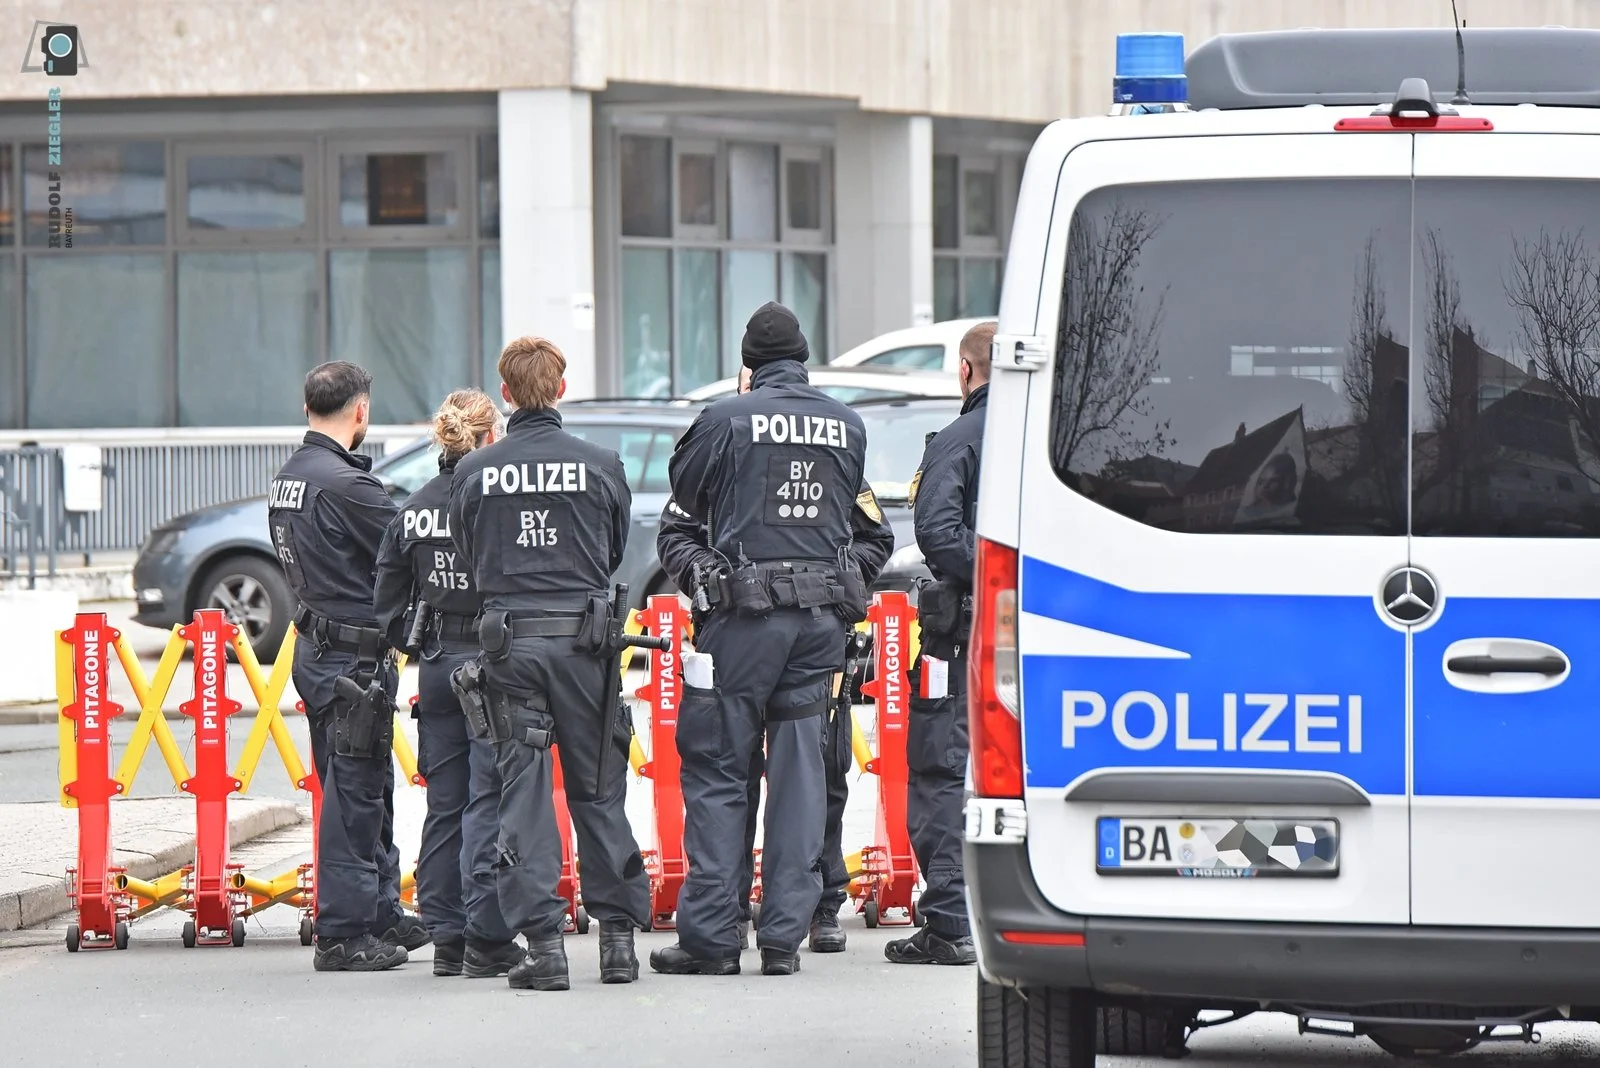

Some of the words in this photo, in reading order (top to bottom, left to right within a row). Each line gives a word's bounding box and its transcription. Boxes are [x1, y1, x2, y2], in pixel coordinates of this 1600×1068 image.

[751, 413, 847, 449] POLIZEI
[482, 462, 587, 495] POLIZEI
[790, 461, 815, 480] BY
[269, 480, 307, 509] OLIZEI
[776, 482, 824, 501] 4110
[520, 510, 550, 530] BY
[516, 528, 558, 548] 4113
[434, 551, 456, 570] BY
[427, 570, 469, 590] 4113
[84, 630, 99, 729] PITAGONE
[203, 630, 217, 729] PITAGONE
[886, 615, 901, 714] PITAGONE
[1062, 690, 1362, 754] POLIZEI
[1105, 846, 1114, 860] D
[1123, 826, 1172, 861] BA
